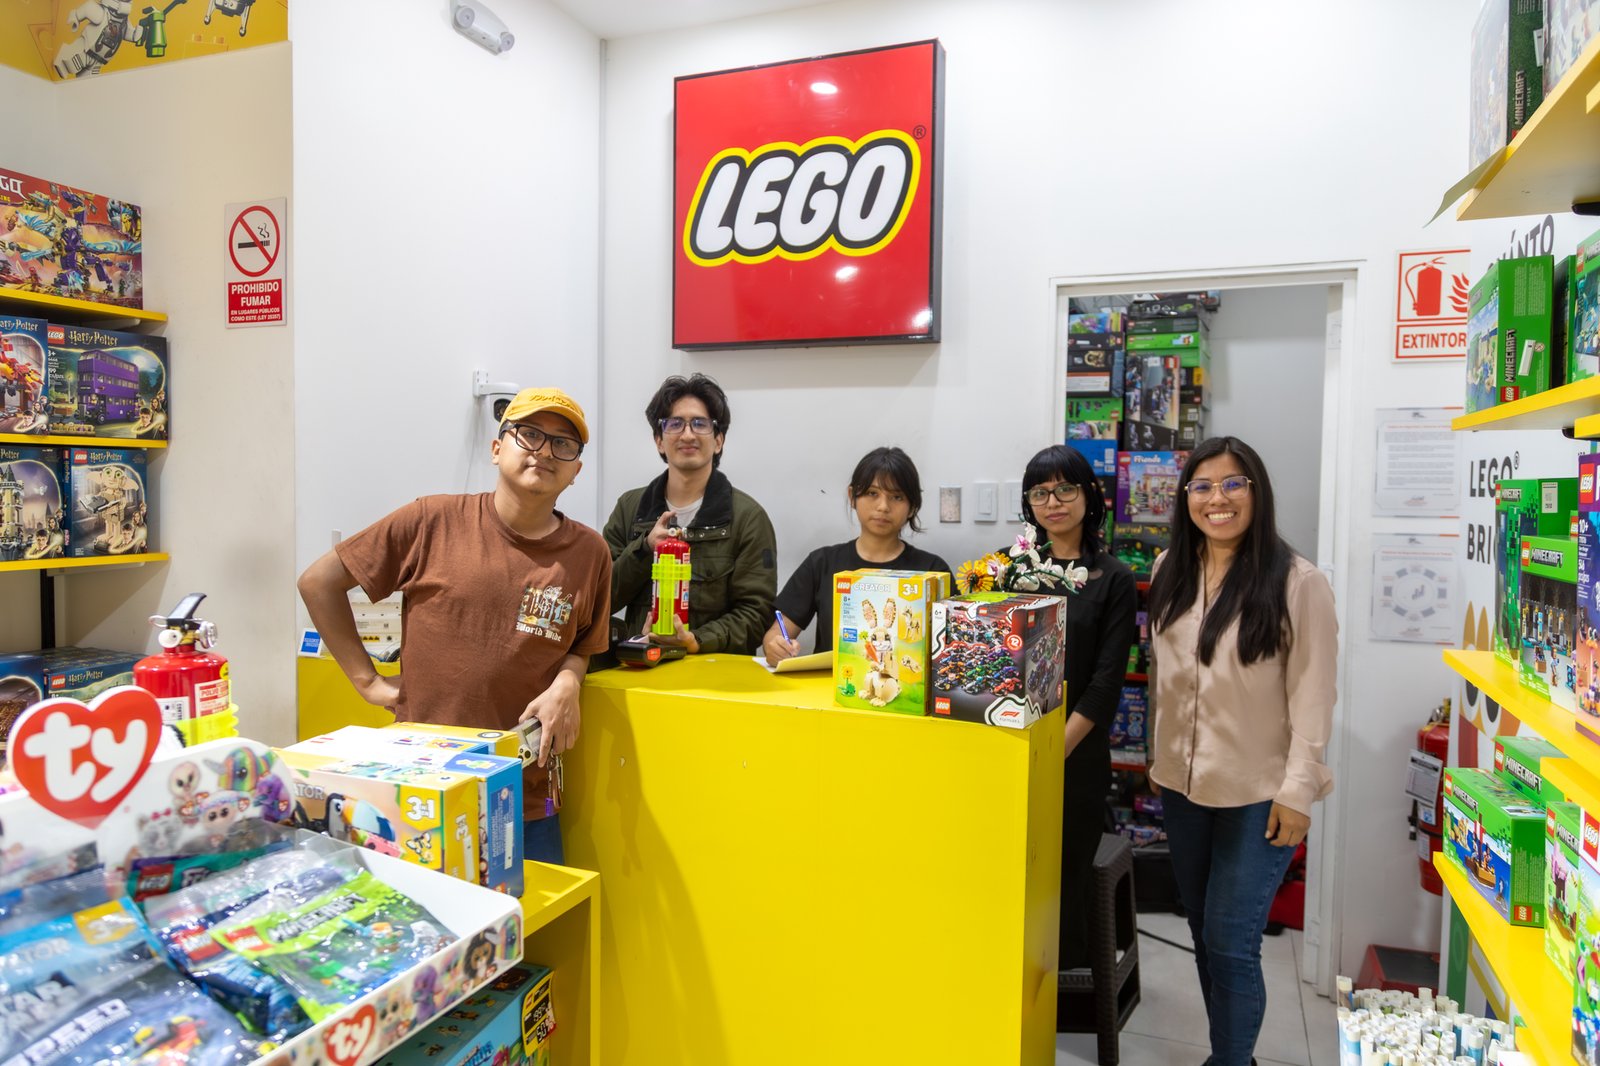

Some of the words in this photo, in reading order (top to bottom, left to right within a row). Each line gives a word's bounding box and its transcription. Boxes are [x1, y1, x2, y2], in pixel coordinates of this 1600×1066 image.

[1515, 69, 1526, 125] MINECRAFT
[231, 281, 279, 294] PROHIBIDO
[241, 295, 271, 307] FUMAR
[15, 319, 39, 332] Potter
[47, 331, 64, 339] LEGO
[69, 330, 93, 346] Harry
[93, 331, 119, 347] Potter
[1505, 329, 1516, 383] MINECRAFT
[1505, 387, 1515, 401] LEGO
[1467, 523, 1498, 565] BRI
[1531, 547, 1563, 568] MINECRAFT
[853, 583, 891, 593] CREATOR
[516, 621, 543, 636] World
[24, 711, 148, 803] ty
[1506, 753, 1543, 795] MINECRAFT
[268, 892, 368, 943] MINECRAFT
[1518, 906, 1528, 921] LEGO
[328, 1013, 371, 1060] ty
